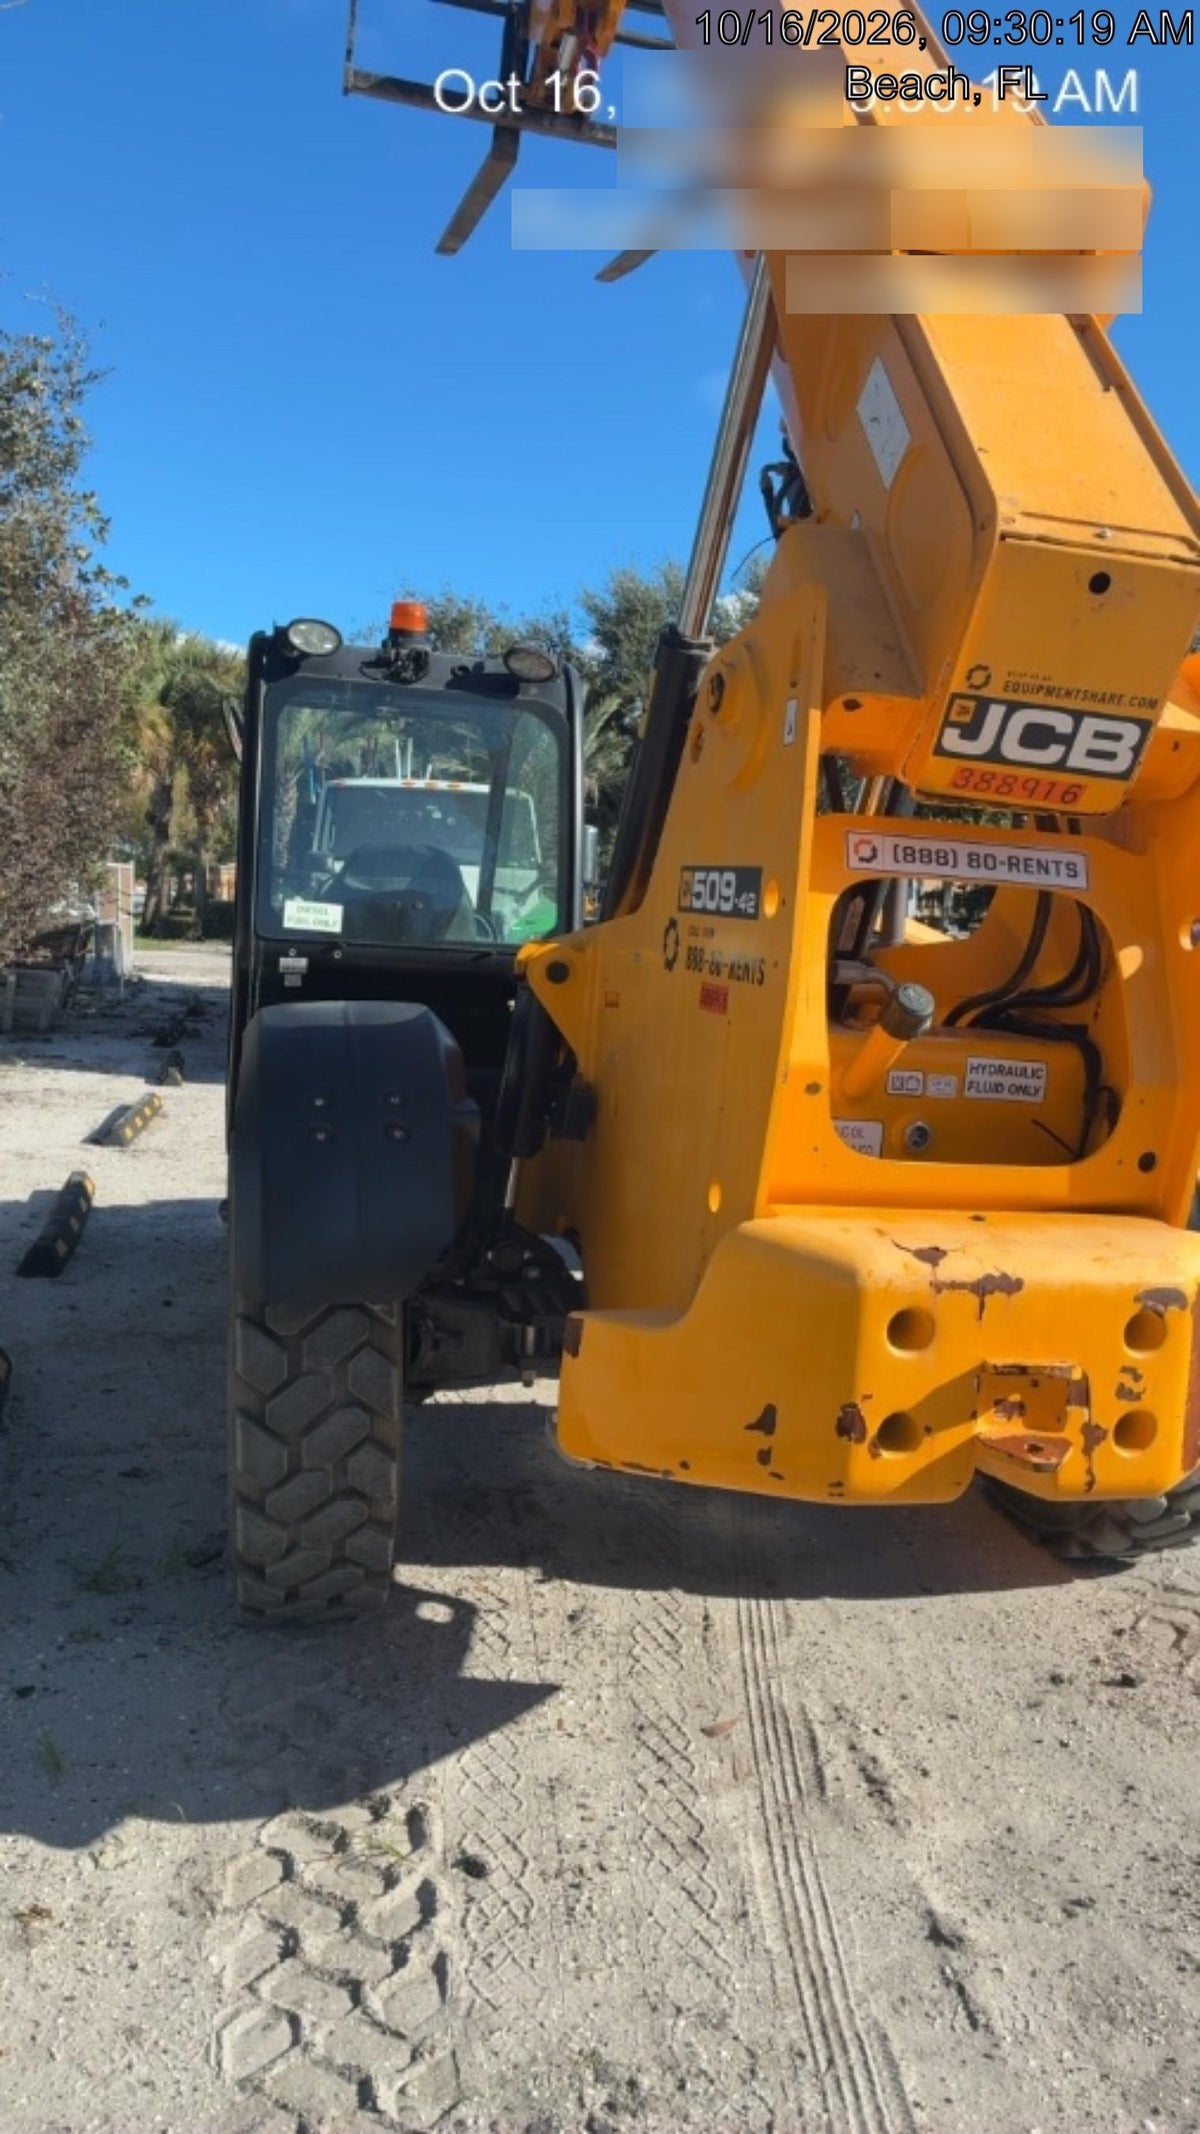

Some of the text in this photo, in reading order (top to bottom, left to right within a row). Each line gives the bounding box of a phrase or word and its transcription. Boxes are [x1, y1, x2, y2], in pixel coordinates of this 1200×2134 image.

[941, 703, 1143, 774] JCB
[952, 767, 1084, 805] 388916
[892, 843, 1079, 879] (888) 80-RENTS
[967, 1080, 1005, 1094] FLUID
[1008, 1083, 1042, 1097] ONLY
[970, 1062, 1044, 1079] HYDRAULIC
